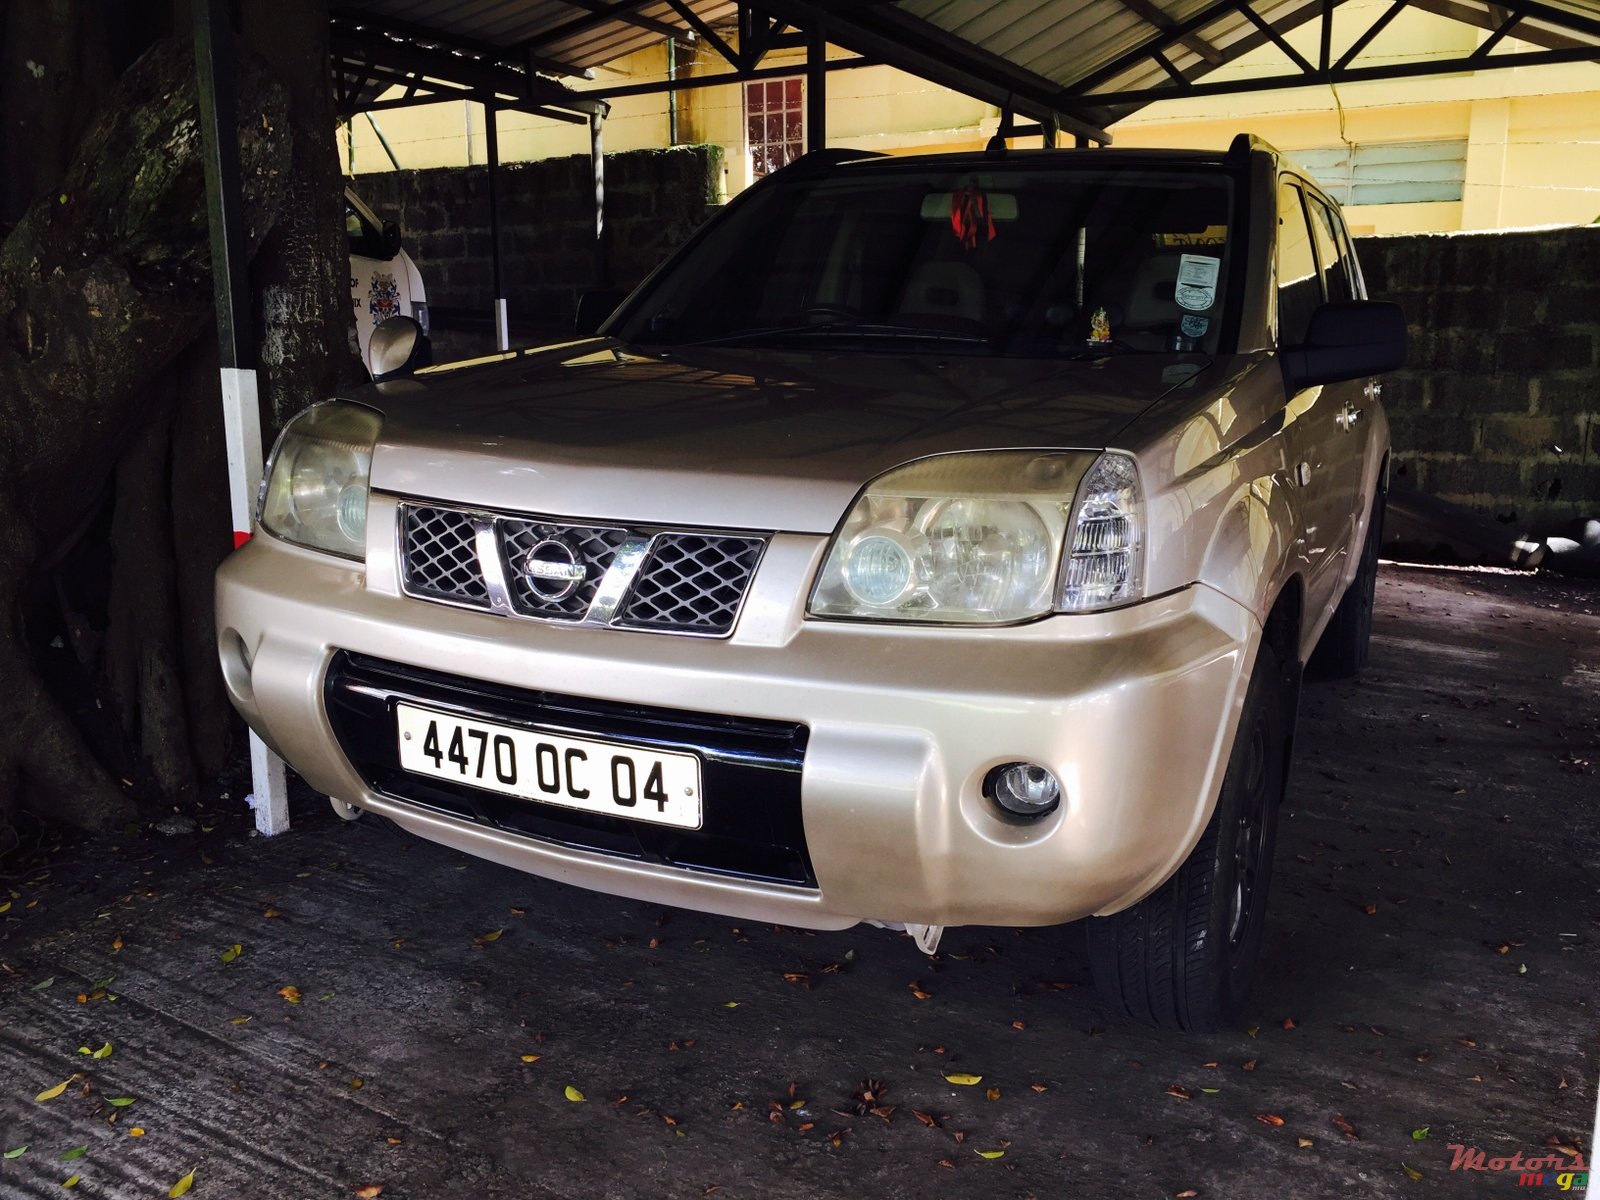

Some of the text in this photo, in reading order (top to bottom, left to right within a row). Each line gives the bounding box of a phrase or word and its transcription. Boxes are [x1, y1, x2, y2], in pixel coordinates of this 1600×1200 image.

[528, 562, 577, 577] ISSAN
[423, 719, 669, 813] 4470 OC 04
